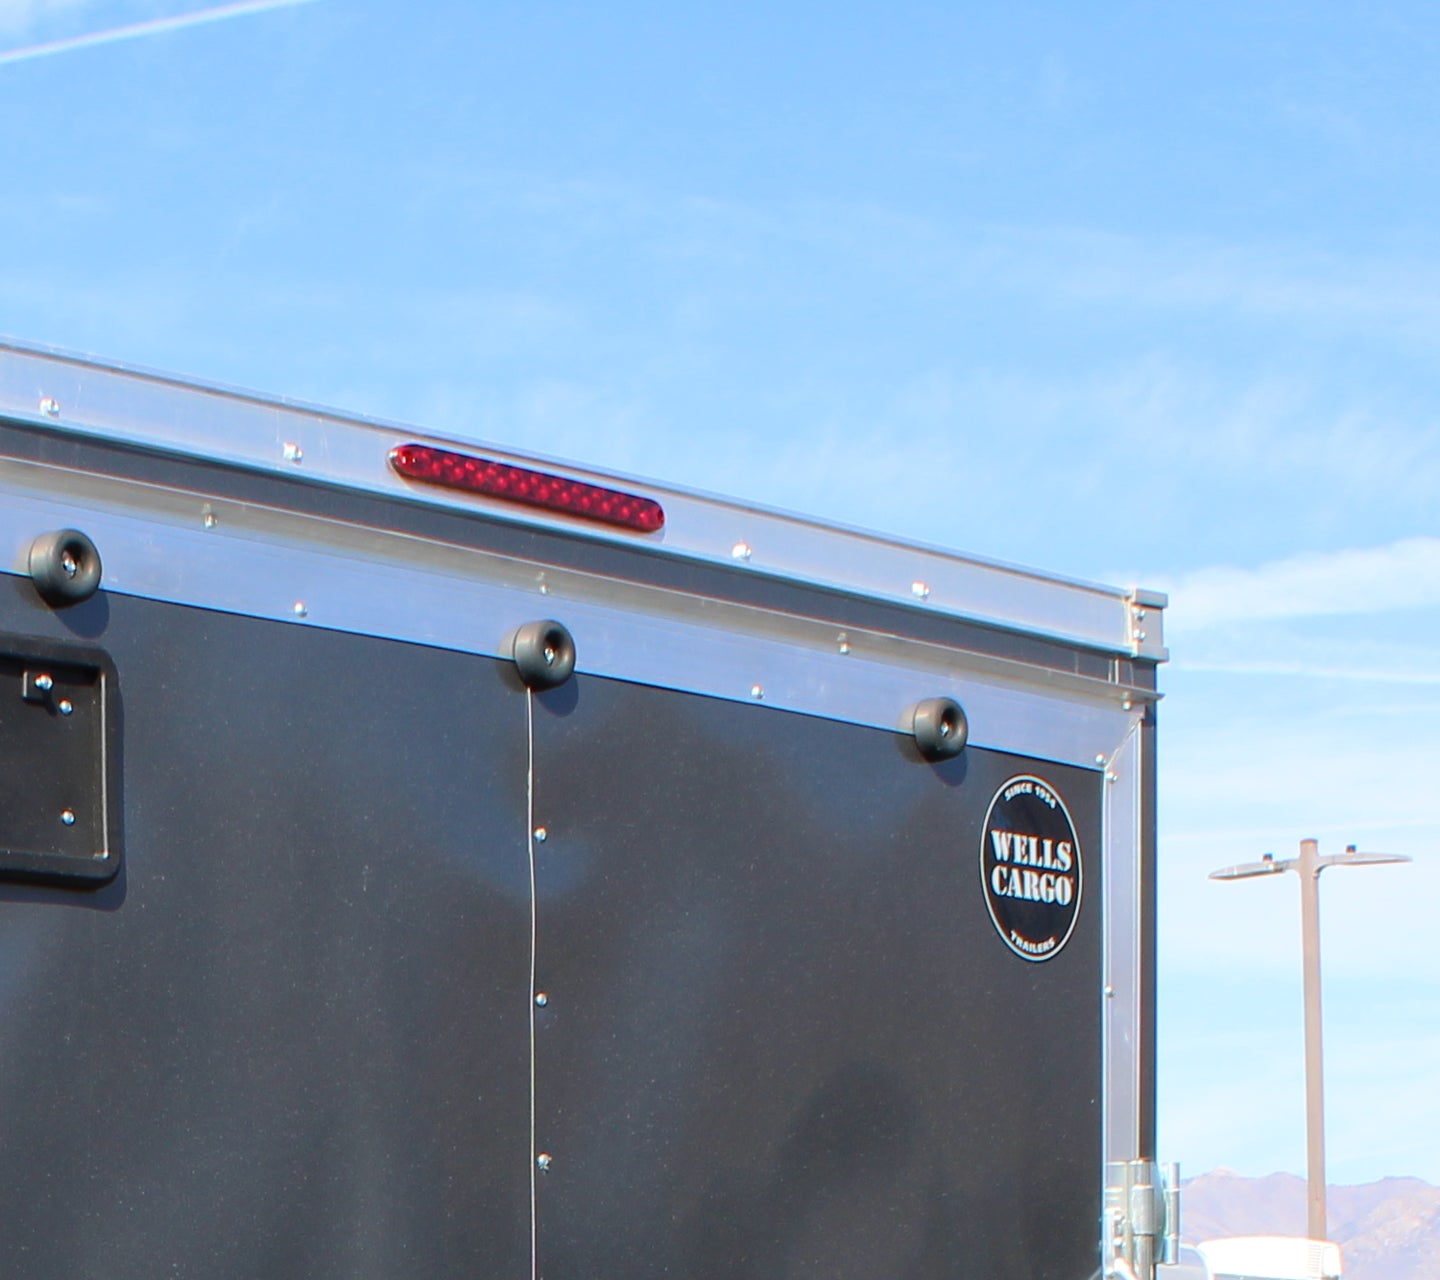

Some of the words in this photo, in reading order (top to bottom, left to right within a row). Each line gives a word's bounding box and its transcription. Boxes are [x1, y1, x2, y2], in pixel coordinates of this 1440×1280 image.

[990, 830, 1072, 872] WELLS
[991, 865, 1072, 906] CARGO
[1010, 930, 1056, 954] TRAILERS
